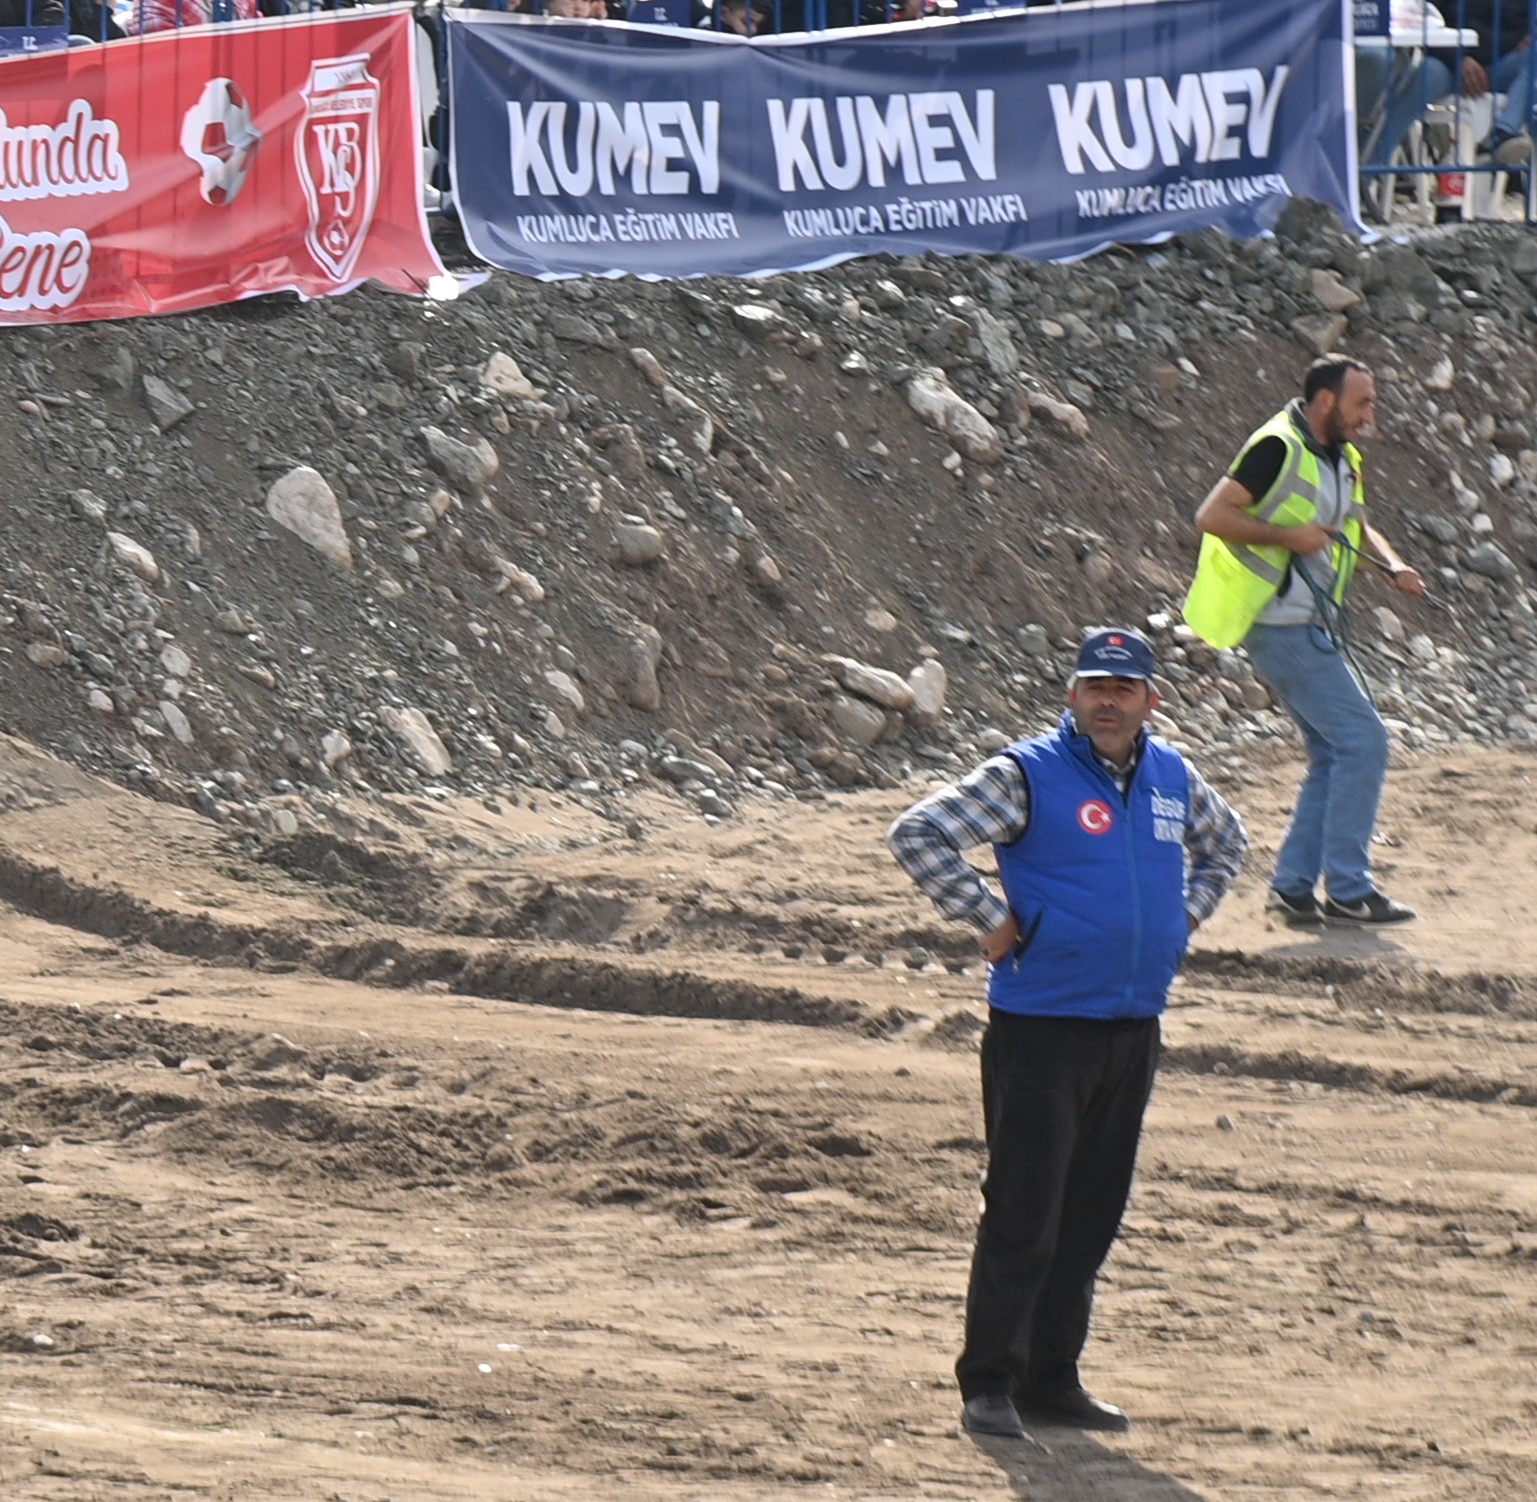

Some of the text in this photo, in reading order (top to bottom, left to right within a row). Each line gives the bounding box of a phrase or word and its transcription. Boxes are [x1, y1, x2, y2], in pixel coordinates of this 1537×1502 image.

[506, 100, 720, 197] KUMEV
[766, 88, 998, 191] KUMEV
[1047, 65, 1290, 174] KUMEV
[516, 206, 741, 243] KUMLUCA EĞİTİM VAKFI
[783, 193, 1029, 238] KUMLUCA EĞİTİM VAKFI
[1074, 184, 1163, 218] KUMLUCA
